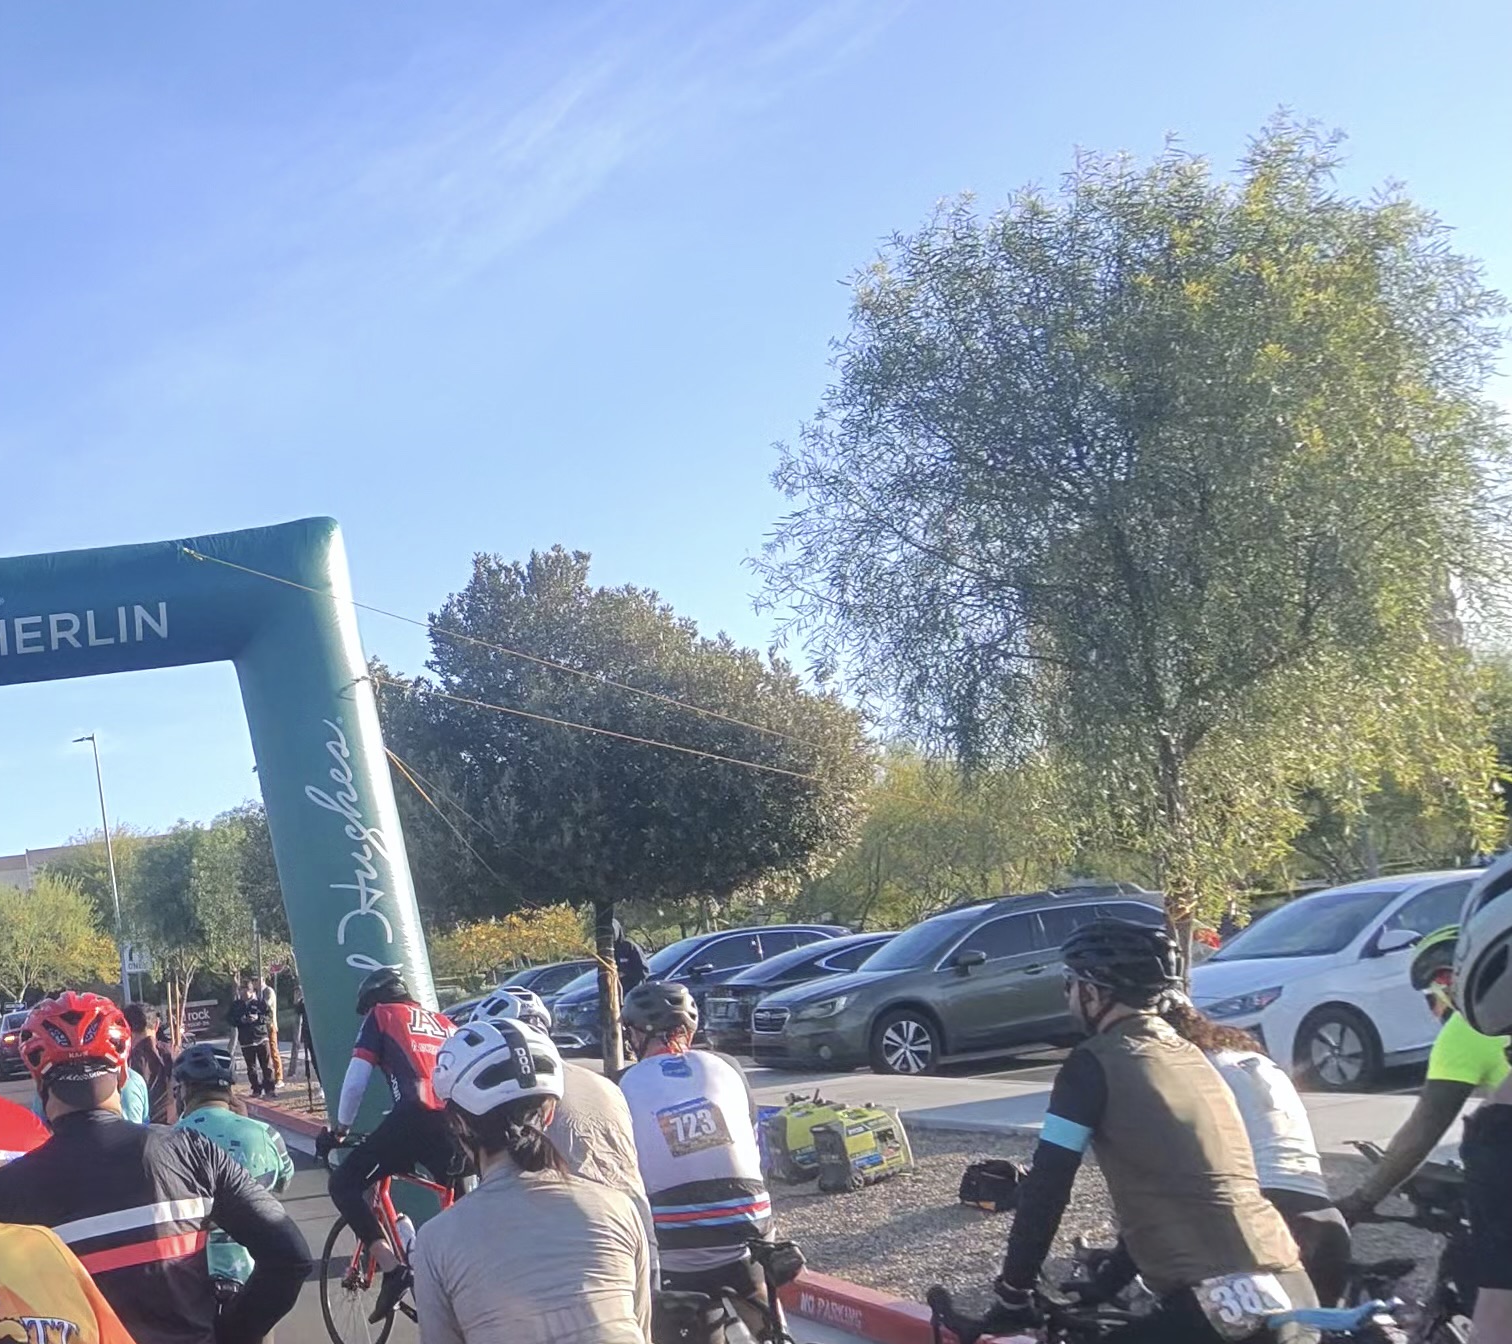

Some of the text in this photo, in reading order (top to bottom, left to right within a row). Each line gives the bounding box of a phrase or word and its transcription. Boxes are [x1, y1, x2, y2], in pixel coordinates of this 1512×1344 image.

[305, 719, 392, 946] Hughes
[668, 1109, 718, 1146] 723
[800, 1292, 863, 1329] NO PARKING
